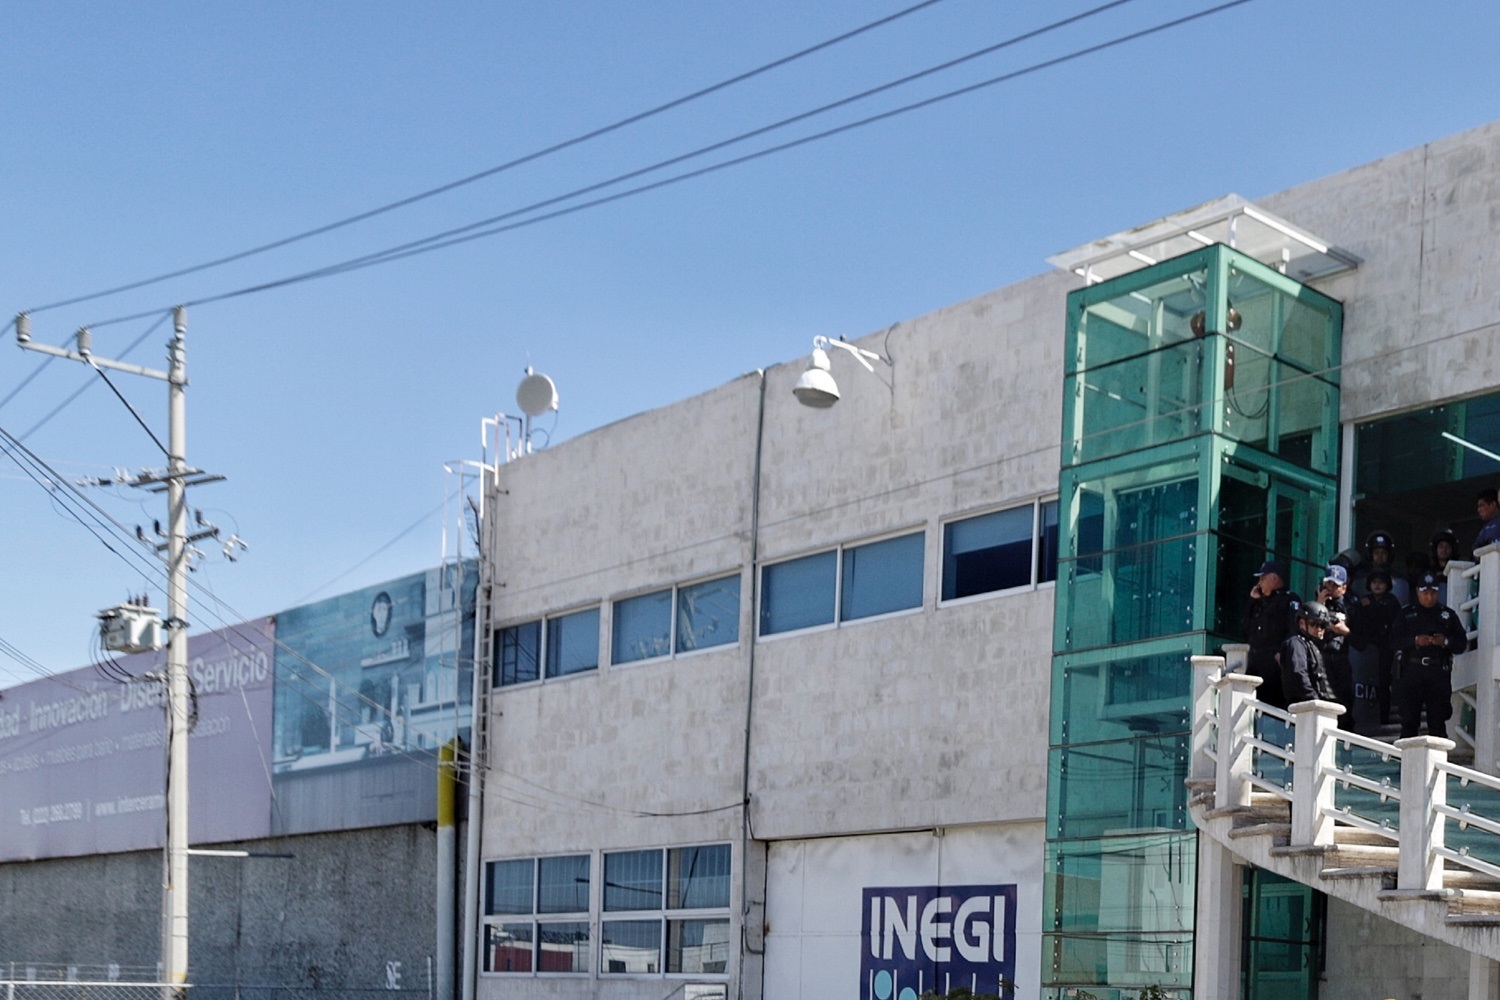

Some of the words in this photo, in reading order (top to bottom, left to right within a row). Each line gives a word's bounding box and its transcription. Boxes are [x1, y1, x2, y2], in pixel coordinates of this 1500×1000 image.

[30, 682, 108, 732] Innovación
[192, 646, 268, 694] Servicio
[871, 895, 1006, 963] INEGI
